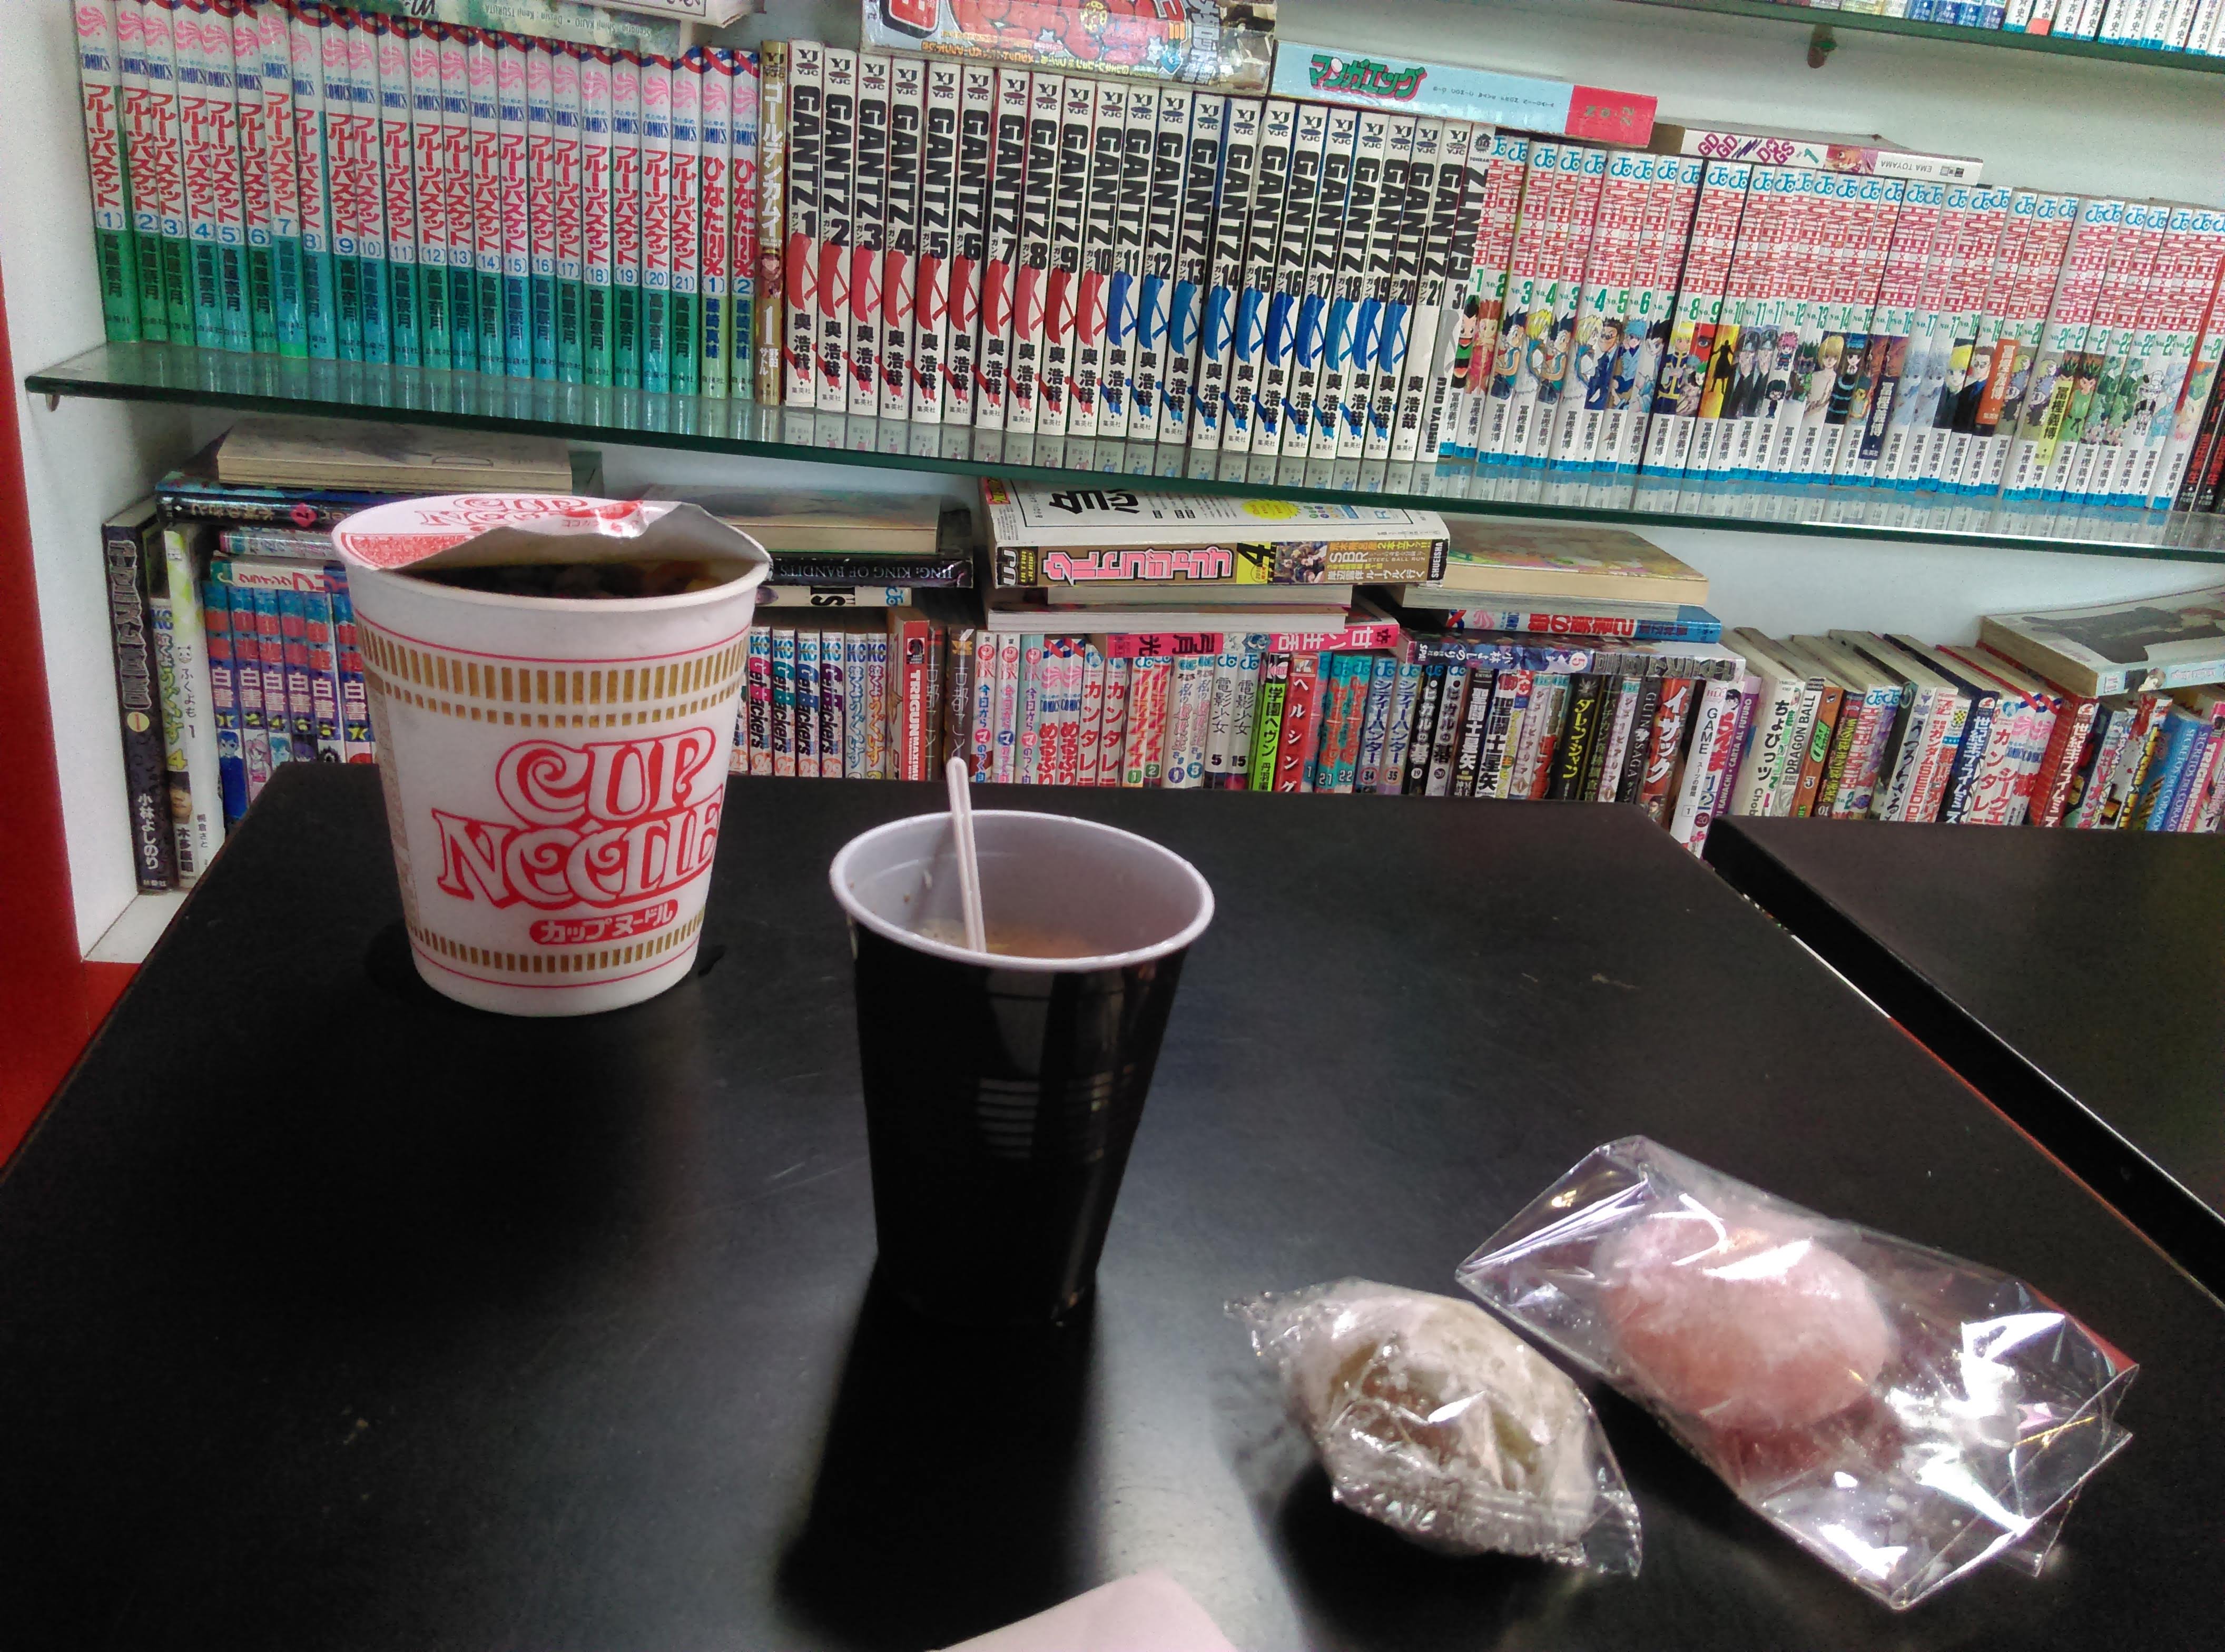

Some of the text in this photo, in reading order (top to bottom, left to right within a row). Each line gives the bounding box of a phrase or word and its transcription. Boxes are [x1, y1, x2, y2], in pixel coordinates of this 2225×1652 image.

[1309, 54, 1427, 102] マンガエッグ
[85, 83, 120, 208] フルーツバスケット
[125, 87, 158, 211] フルーツバスケット
[149, 92, 182, 215] フルーツバスケット
[209, 100, 240, 223] フルーツバスケット
[265, 91, 296, 215] フルーツバスケット
[328, 113, 358, 234] フルーツバスケット
[384, 121, 411, 241] フルーツバスケット
[416, 123, 444, 244] フルーツバスケット
[473, 131, 499, 251] フルーツバスケット
[555, 139, 579, 258] フルーツバスケット
[584, 144, 608, 264] フルーツバスケット
[615, 145, 638, 264] フルーツバスケット
[792, 85, 820, 238] GANTZ 1
[823, 94, 853, 247] GANTZ 2
[856, 99, 886, 251] GANTZ 3
[889, 104, 919, 256] GANTZ 4
[923, 107, 954, 259] GANTZ 5
[957, 110, 989, 260] GANTZ 6
[1023, 119, 1057, 270] GANTZ 8
[1055, 124, 1088, 273] GANTZ 9
[1088, 126, 1122, 276] GANTZ 10
[1880, 159, 1933, 172] EMA TOYAMA
[644, 149, 668, 269] フルーツバスケット
[672, 152, 696, 271] フルーツバスケット
[762, 83, 783, 345] ゴールデンカムイ 1
[1149, 132, 1184, 280] GANTZ 12
[1217, 144, 1253, 291] GANTZ 14
[1249, 145, 1287, 293] GANTZ 15
[1311, 153, 1350, 299] GANTZ 17
[1341, 157, 1381, 302] GANTZ 18
[1394, 162, 1435, 306] GANTZ 20
[1423, 163, 1463, 306] GANTZ 21
[1449, 168, 1488, 310] GANTZ 31
[1425, 377, 1447, 453] HIROYA OKU
[781, 565, 846, 578] BANDITS
[849, 566, 869, 577] OF
[873, 566, 911, 579] KING
[1003, 549, 1017, 585] UJ
[1042, 547, 1233, 586] ウルトラジャンプ
[1330, 551, 1369, 563] SBR
[1431, 542, 1443, 578] SHUEISHA
[1278, 626, 1372, 651] 甘い生活
[168, 749, 188, 770] 4
[909, 670, 921, 736] TRIGUN
[1212, 677, 1232, 765] 電影少女 5
[1232, 680, 1254, 767] 電影少女 15
[1281, 679, 1308, 792] ヘルシング
[1628, 693, 1657, 777] GUIN SAGA
[1646, 687, 1686, 783] イサック
[1699, 708, 1717, 754] GAME
[1728, 741, 1741, 767] CARTA
[1738, 729, 1745, 739] AL
[1740, 699, 1753, 728] FUTURO
[1758, 700, 1789, 781] ちょびっツ
[1785, 696, 1816, 774] DRAGON BALL
[496, 726, 716, 825] CUP
[2167, 732, 2208, 831] SECRETOS CORAZO
[2192, 742, 2217, 798] TRIGUN
[137, 793, 159, 869] 小林よしのり
[540, 903, 674, 945] カップヌードル
